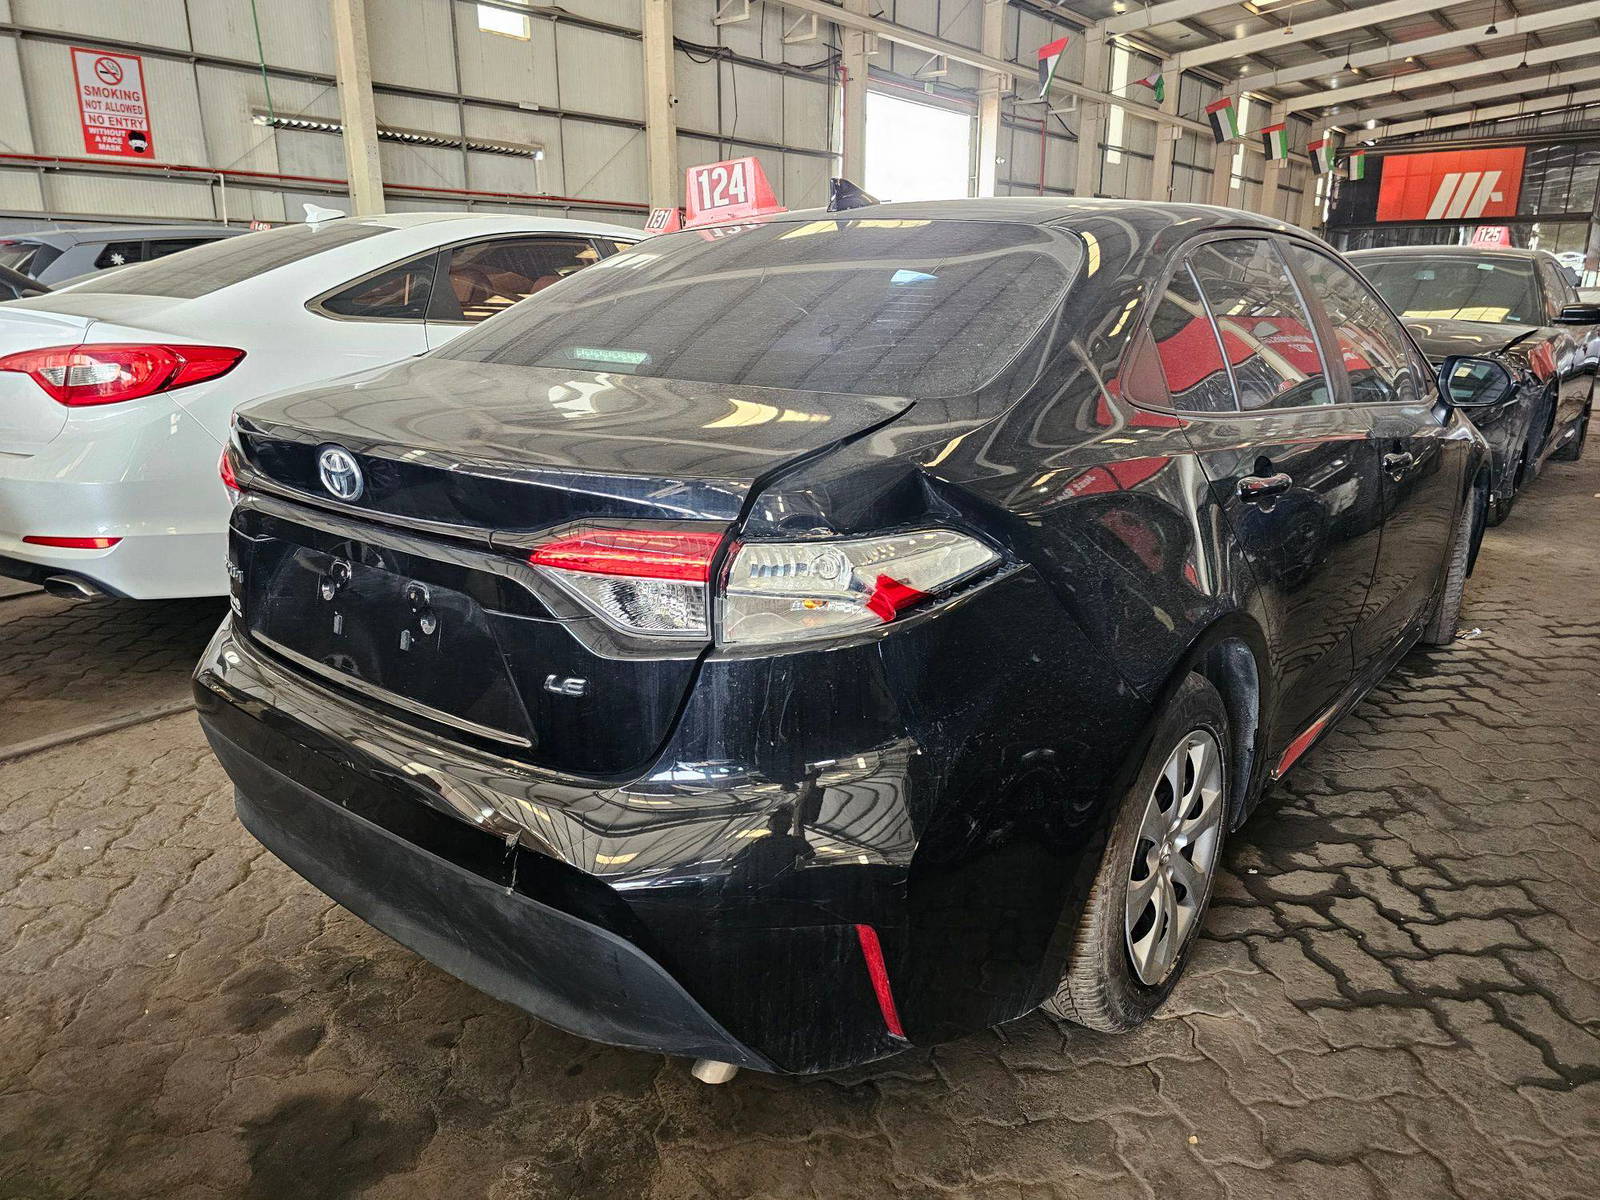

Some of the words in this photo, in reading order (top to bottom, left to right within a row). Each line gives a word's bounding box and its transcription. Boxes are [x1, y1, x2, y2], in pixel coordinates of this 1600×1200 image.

[84, 85, 140, 101] SMOKING
[85, 100, 101, 110] NOT
[105, 102, 143, 114] ALLOWED
[88, 114, 104, 125] NO
[108, 117, 144, 128] ENTRY
[88, 127, 126, 137] WITHOUT
[95, 135, 102, 143] A
[102, 136, 123, 145] FACE
[98, 143, 122, 152] MASK
[698, 163, 745, 209] 124
[649, 209, 670, 229] 131
[1479, 227, 1502, 242] 125
[543, 674, 587, 696] LE
